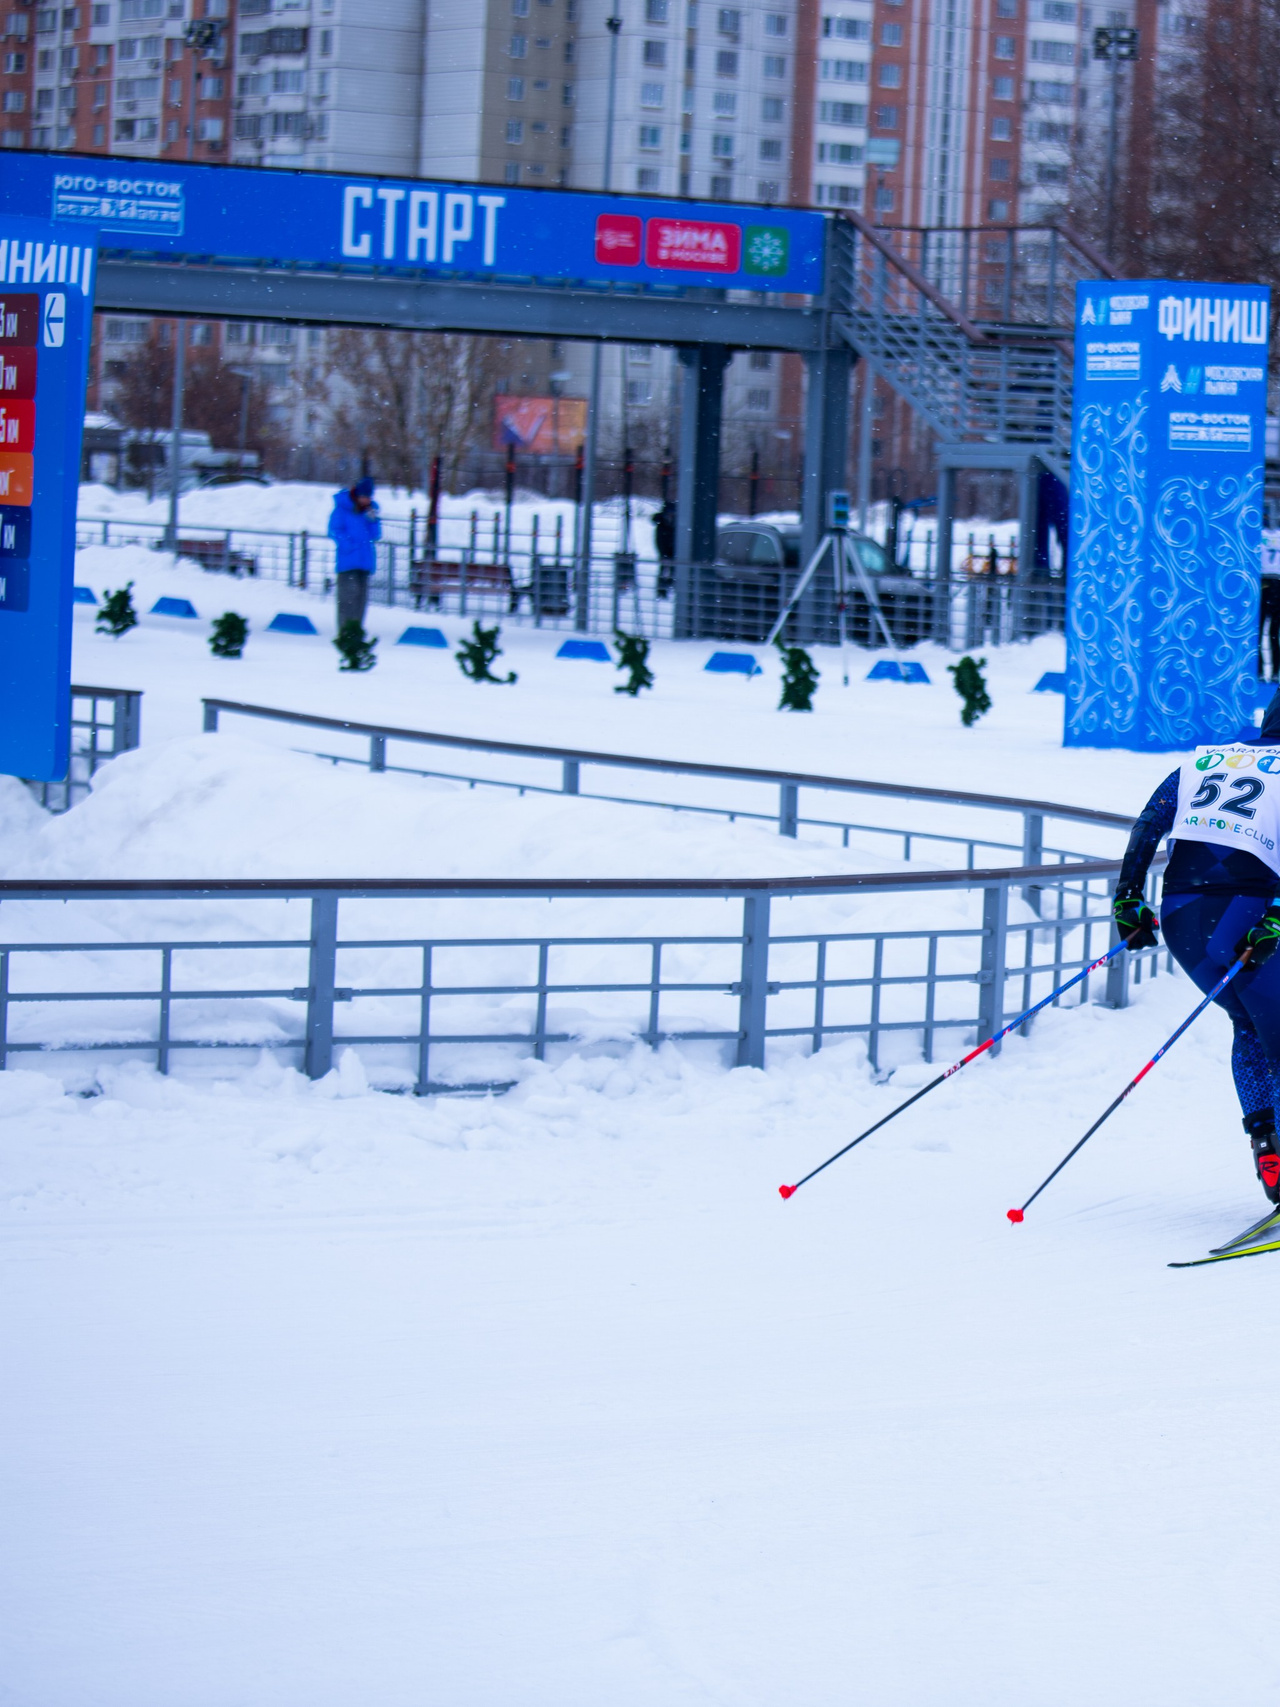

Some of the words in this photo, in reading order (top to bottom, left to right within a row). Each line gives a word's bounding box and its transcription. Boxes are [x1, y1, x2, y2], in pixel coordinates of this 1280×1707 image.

[54, 175, 181, 197] ЮГО-ВОСТОК
[342, 186, 506, 266] СТАРТ
[658, 226, 728, 251] ЗИМА
[1158, 296, 1267, 344] ФИНИШ
[1190, 773, 1265, 820] 52
[1181, 815, 1275, 851] ARAFONE.CLUB
